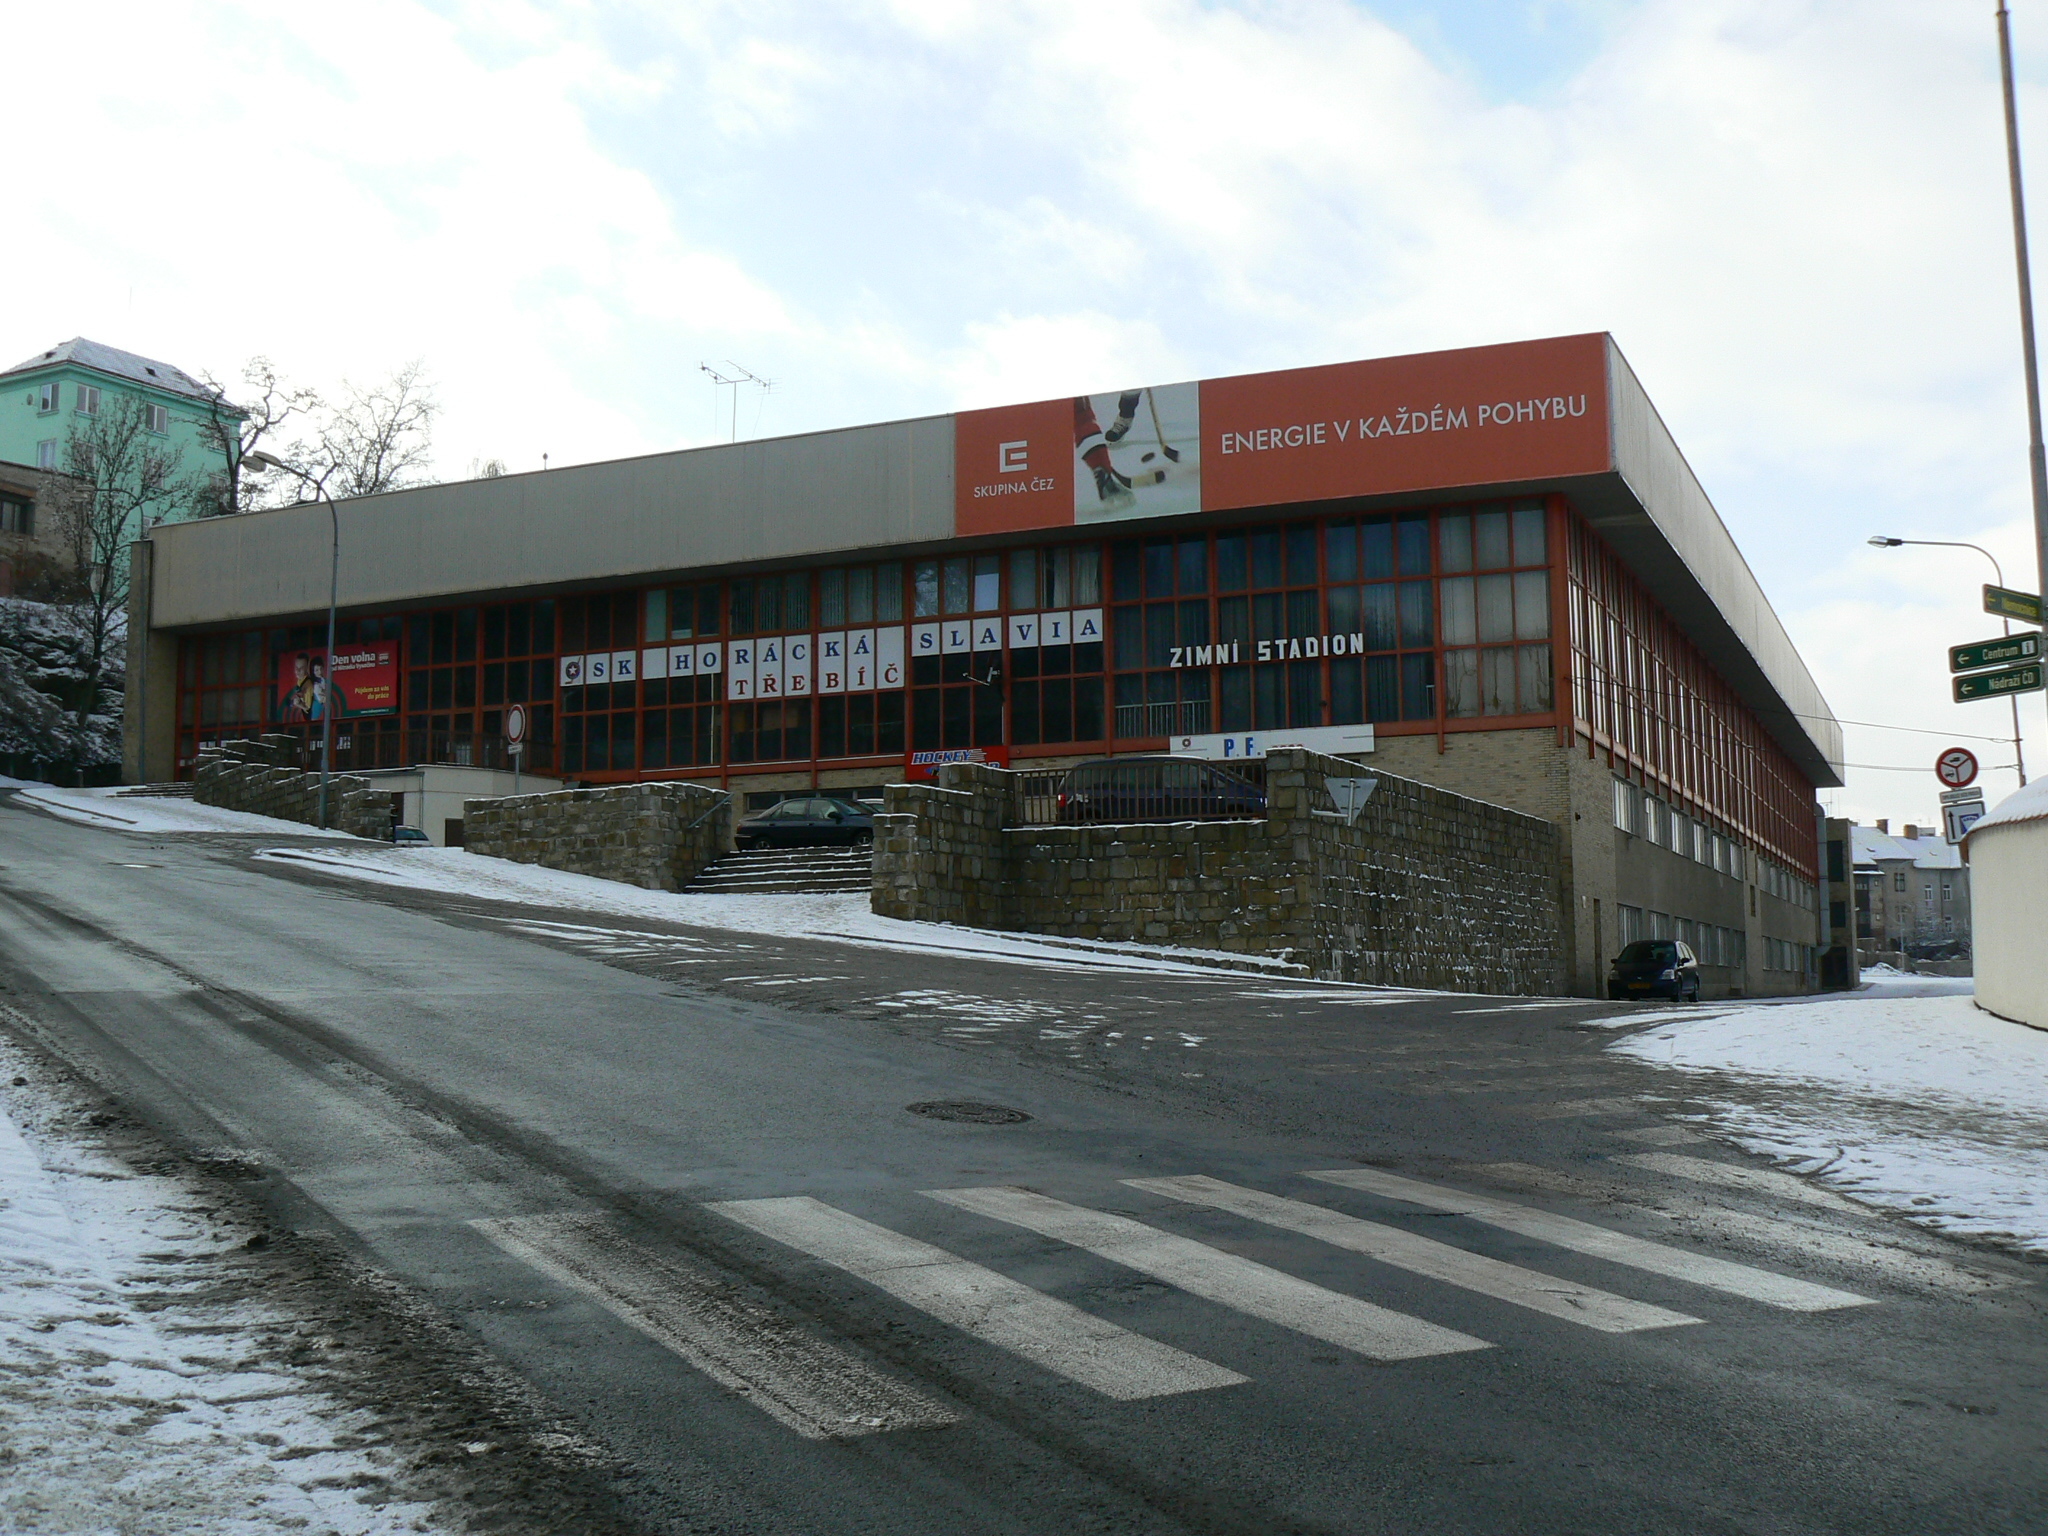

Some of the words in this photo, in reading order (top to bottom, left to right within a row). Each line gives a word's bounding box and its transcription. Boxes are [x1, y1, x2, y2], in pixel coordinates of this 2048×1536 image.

[1221, 422, 1326, 455] ENERGIE
[1333, 420, 1351, 442] V
[1359, 403, 1469, 440] KAŽDÉM
[1478, 394, 1587, 428] POHYBU
[973, 480, 1028, 499] SKUPINA
[1030, 476, 1055, 492] ČEZ
[332, 655, 350, 665] Den
[351, 652, 376, 662] volna
[593, 659, 633, 678] SK
[675, 634, 870, 670] HORÁCKÁ
[920, 619, 1098, 649] SLAVIA
[1170, 638, 1239, 668] ZIMNÍ
[1258, 632, 1364, 661] STADION
[1982, 646, 2018, 660] Centrum
[735, 662, 899, 695] TŘEBÍČ
[1988, 674, 2020, 690] Nádraží
[2022, 669, 2034, 685] ČD
[911, 750, 973, 765] HOCKEY
